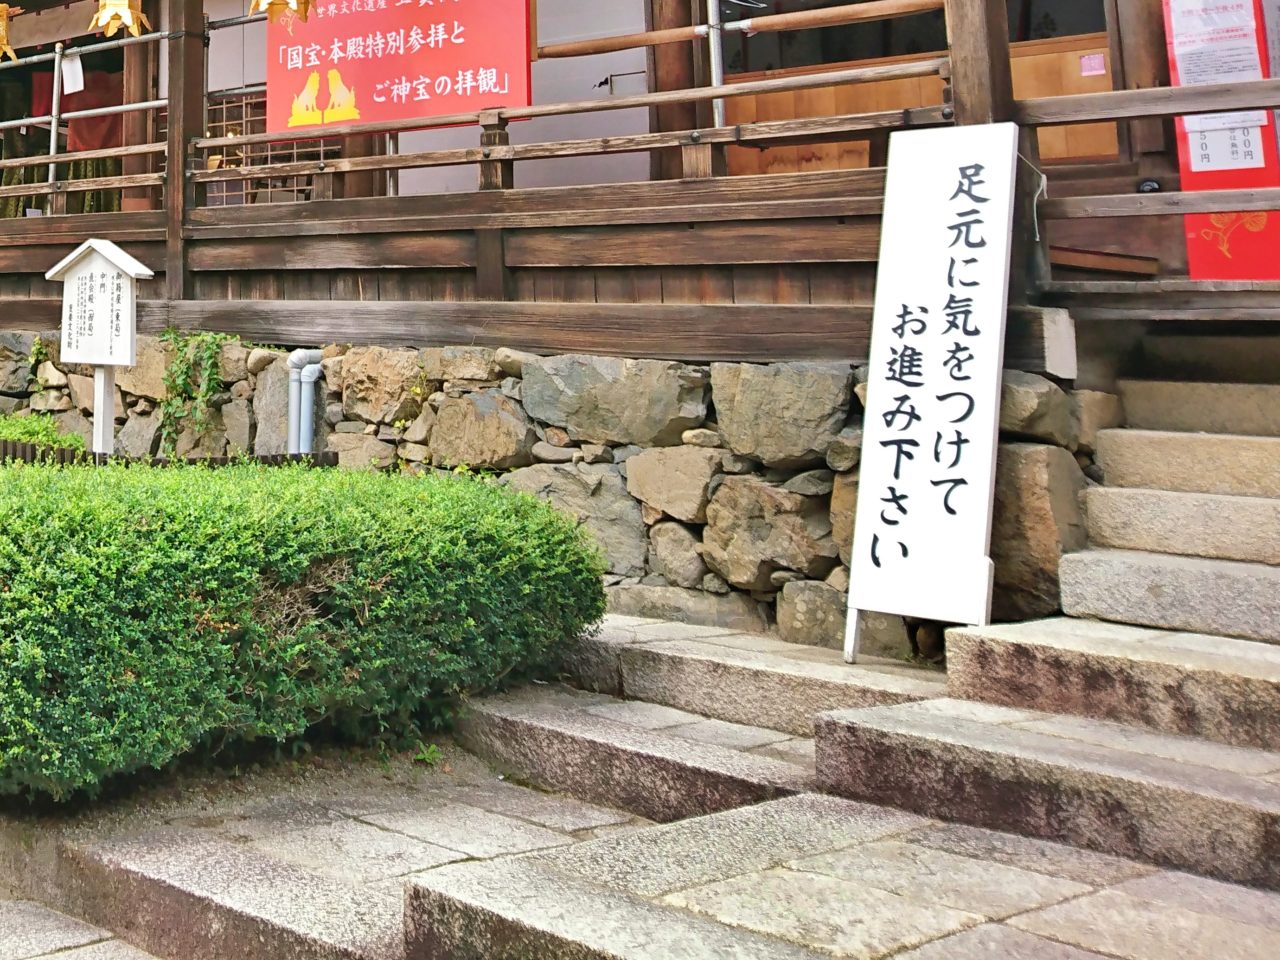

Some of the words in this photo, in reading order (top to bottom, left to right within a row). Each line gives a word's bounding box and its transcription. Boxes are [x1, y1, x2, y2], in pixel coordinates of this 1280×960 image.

[278, 20, 467, 71] 「国宝・本殿特別参拝と
[372, 66, 510, 105] ご神宝の拝観」
[1242, 127, 1254, 161] 00円
[99, 272, 106, 294] 中門
[929, 162, 993, 516] 足元に気をつけて
[870, 302, 930, 570] お進み下さい
